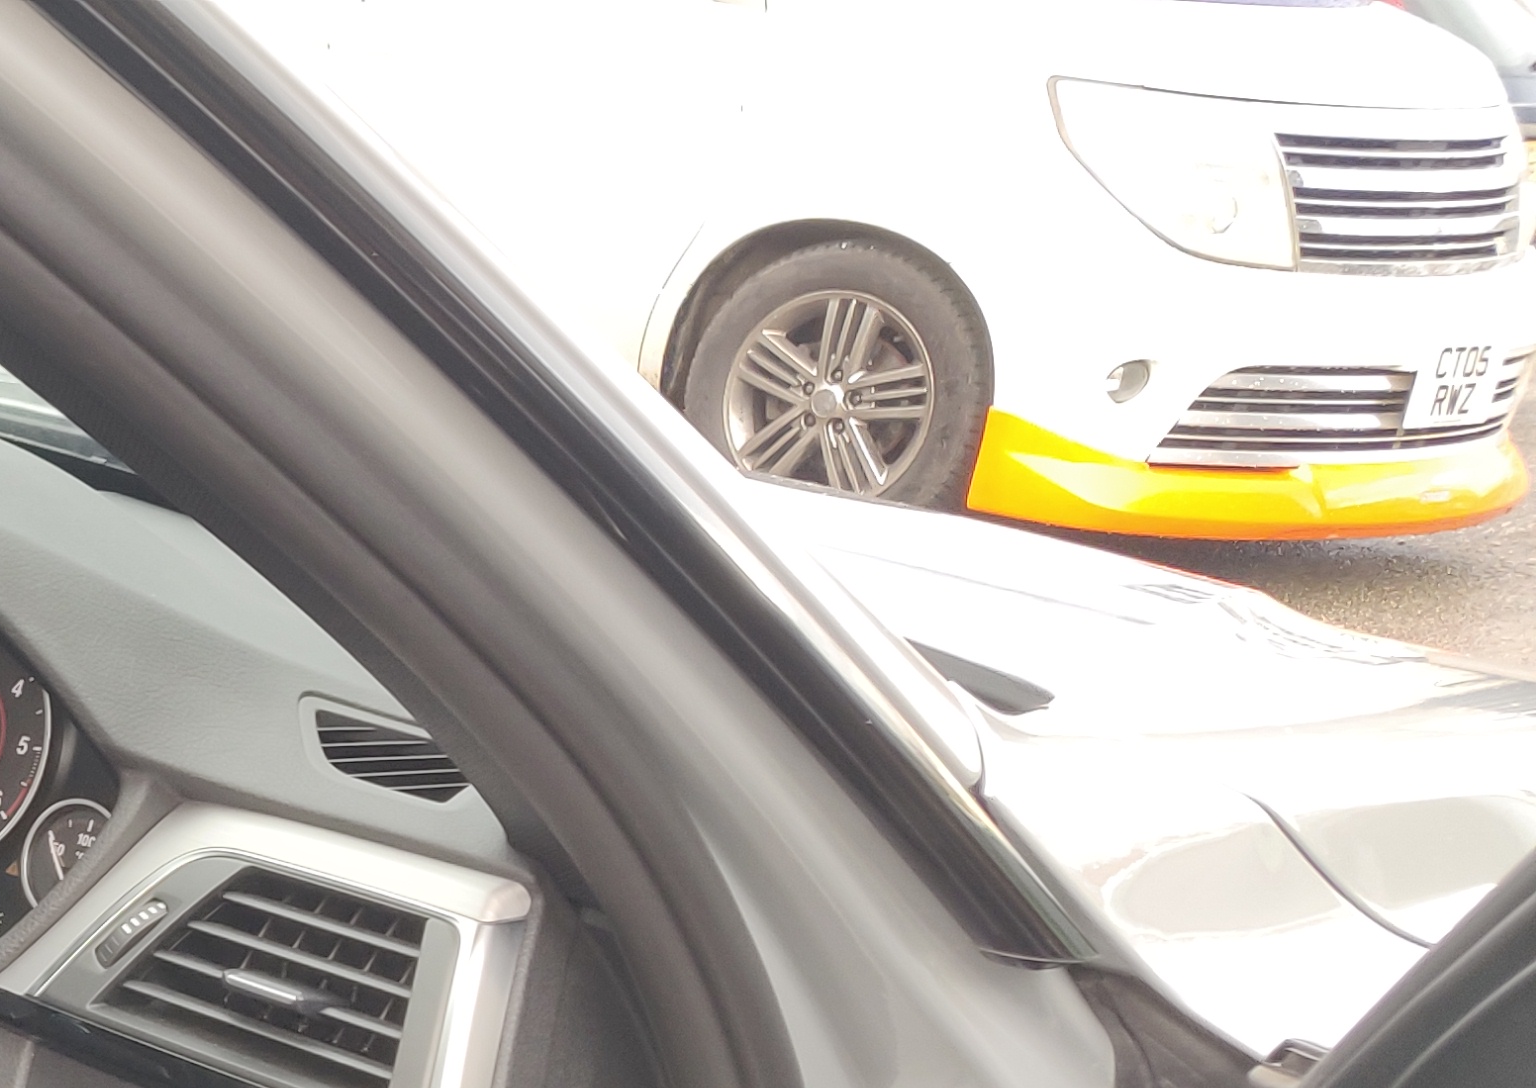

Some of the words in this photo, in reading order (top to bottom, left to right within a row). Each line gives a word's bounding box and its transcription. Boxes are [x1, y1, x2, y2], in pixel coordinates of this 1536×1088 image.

[1430, 383, 1476, 416] RWZ
[11, 679, 25, 698] 4
[16, 736, 31, 755] 5
